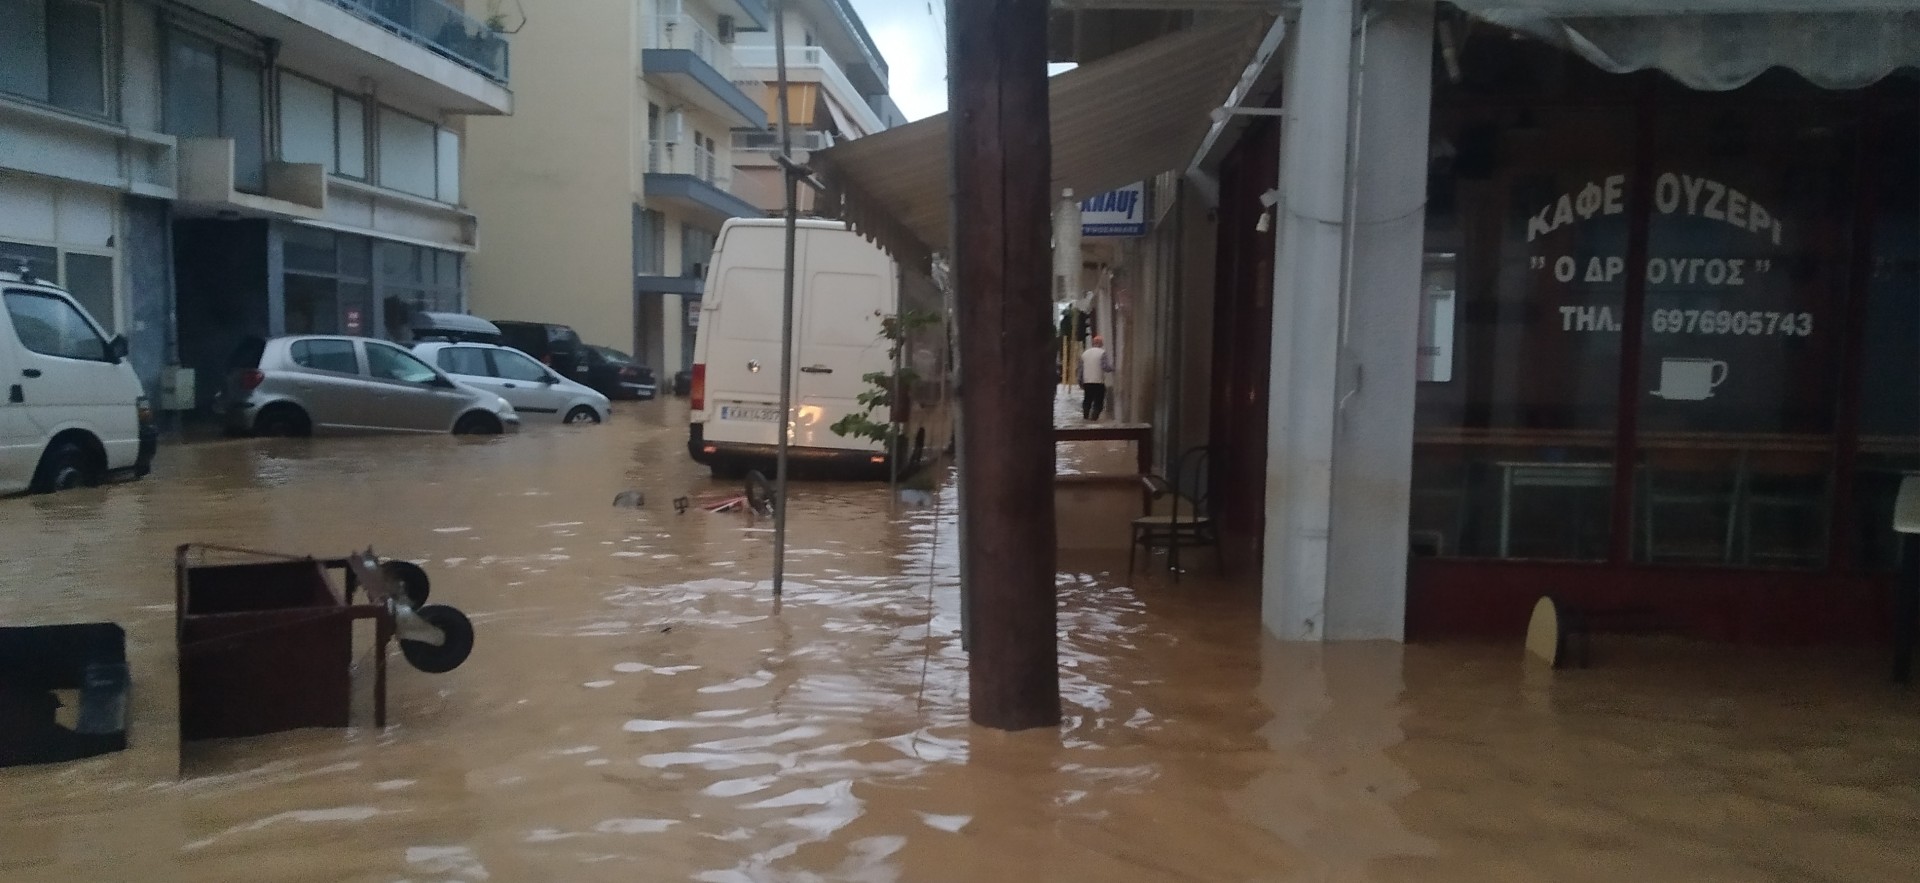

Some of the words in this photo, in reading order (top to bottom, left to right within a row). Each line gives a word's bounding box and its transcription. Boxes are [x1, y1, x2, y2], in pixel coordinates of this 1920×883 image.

[1527, 174, 1625, 243] ΚΑΦΕ
[1655, 172, 1783, 245] ΟΥΖΕΡΙ
[1559, 306, 1622, 333] ΤΗΛ.
[1652, 308, 1814, 336] 6976905743
